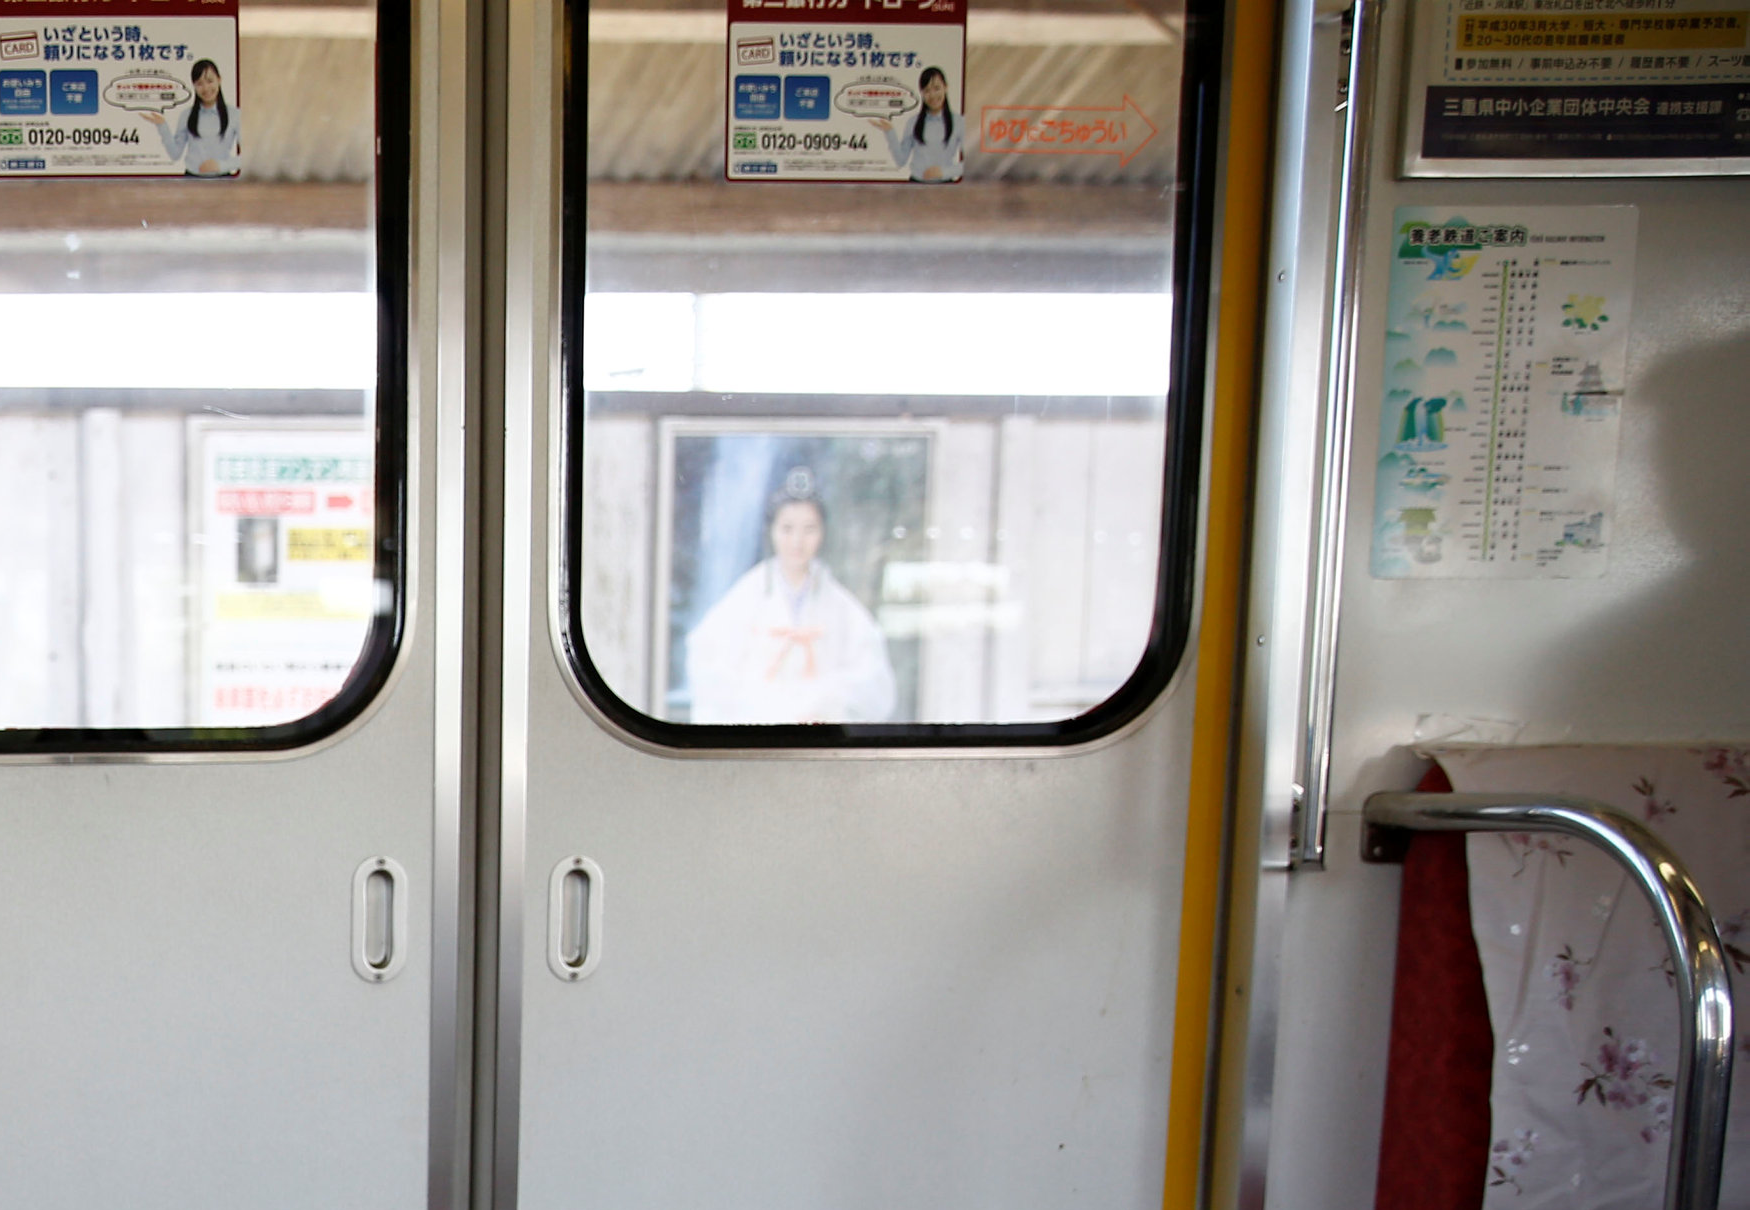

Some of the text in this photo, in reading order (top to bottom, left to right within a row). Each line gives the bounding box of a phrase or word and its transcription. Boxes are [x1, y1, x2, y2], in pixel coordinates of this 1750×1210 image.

[44, 26, 149, 42] いざという時、
[779, 32, 880, 49] いざという時、
[4, 42, 35, 55] CARD
[43, 44, 194, 61] 頼りになる1枚です。
[741, 49, 771, 61] CARD
[1443, 98, 1650, 117] 三重県中小企業団体中央会
[28, 128, 140, 145] 0120-0909-44
[988, 117, 1127, 144] ゆびにごちゅうい
[761, 133, 868, 150] 0120-0909-44
[1410, 228, 1525, 245] 養老鉄道ご案内
